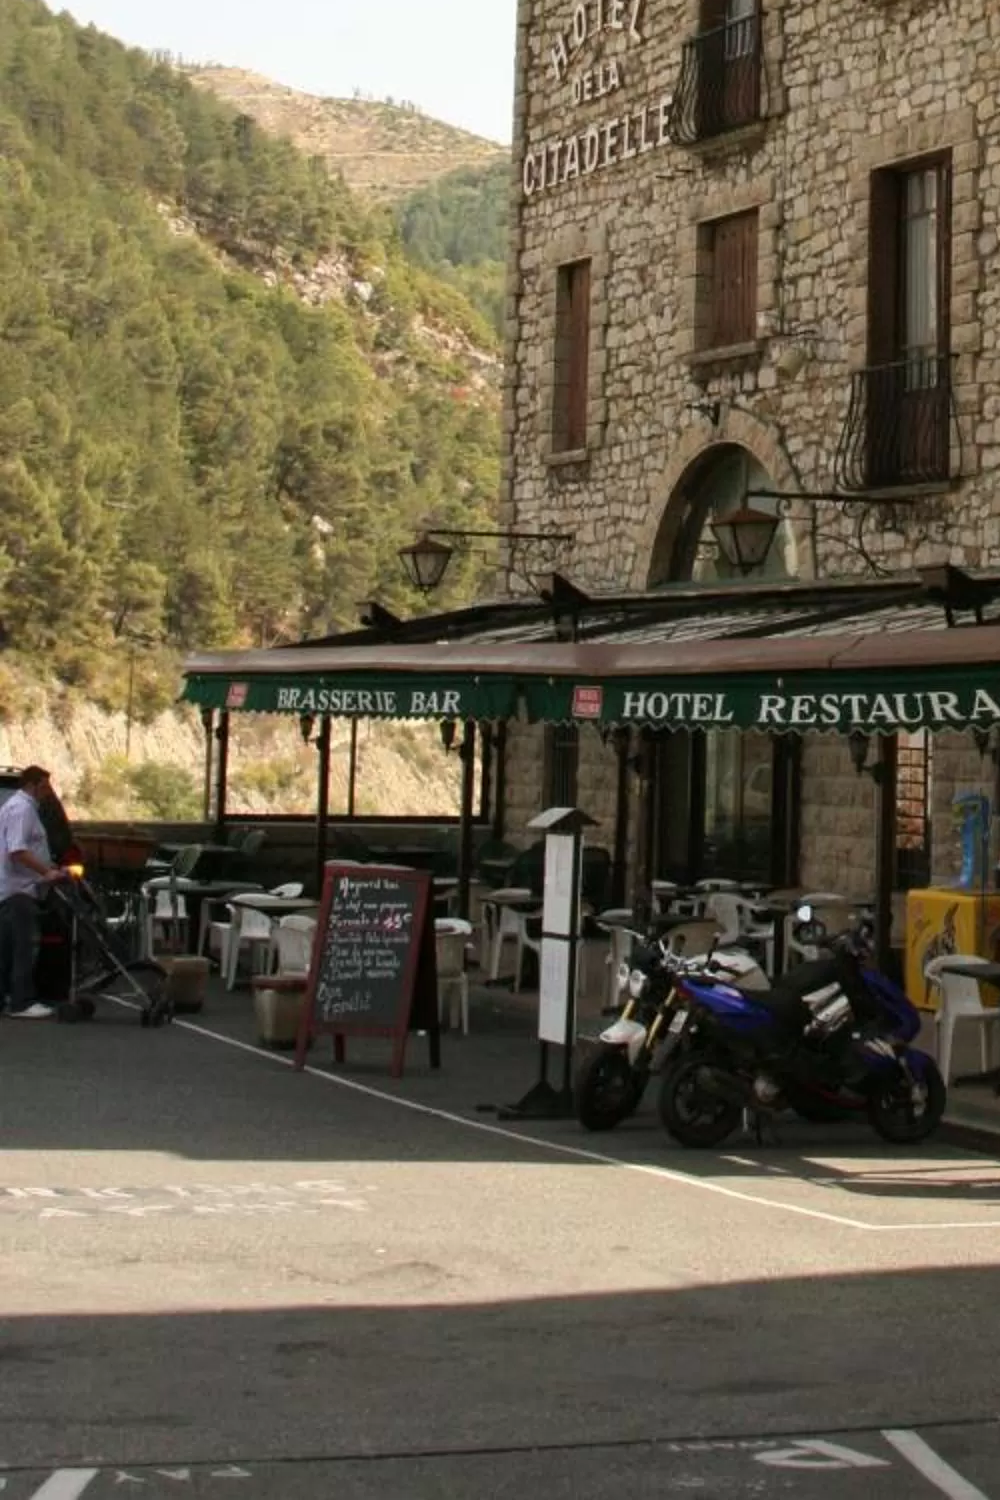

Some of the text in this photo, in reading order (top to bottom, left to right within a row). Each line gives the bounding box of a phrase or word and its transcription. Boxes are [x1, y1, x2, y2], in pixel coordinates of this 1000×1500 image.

[573, 62, 622, 105] DE LA
[523, 95, 674, 197] CITADELLE
[277, 688, 462, 714] BRASSERIE BAR
[622, 690, 735, 722] HOTEL
